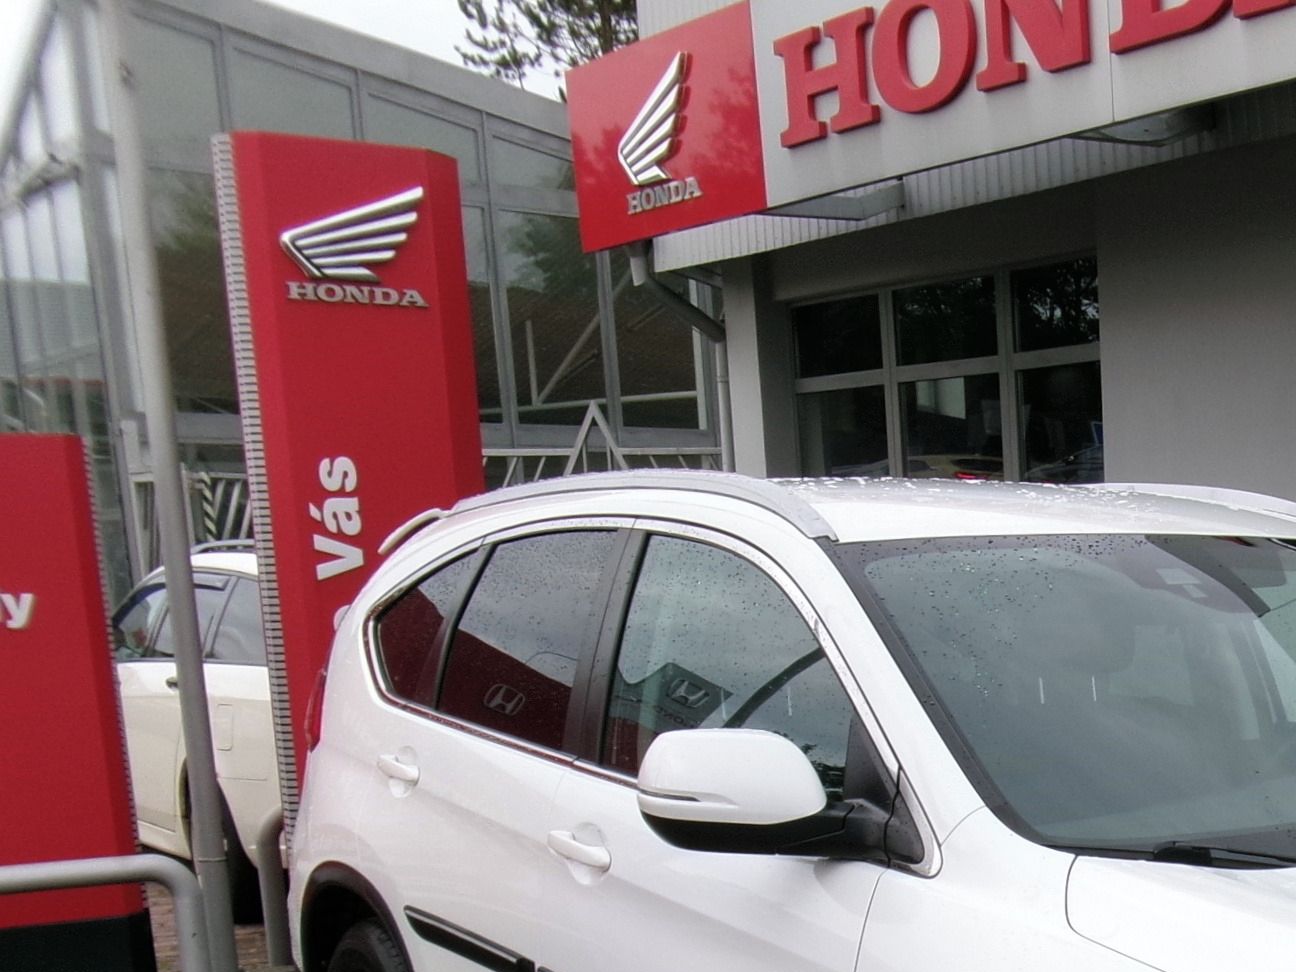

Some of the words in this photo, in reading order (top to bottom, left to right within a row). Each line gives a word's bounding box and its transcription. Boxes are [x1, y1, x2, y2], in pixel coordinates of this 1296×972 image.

[626, 176, 703, 215] HONDA
[286, 281, 430, 307] HONDA
[309, 456, 364, 581] Vás
[0, 593, 35, 629] y
